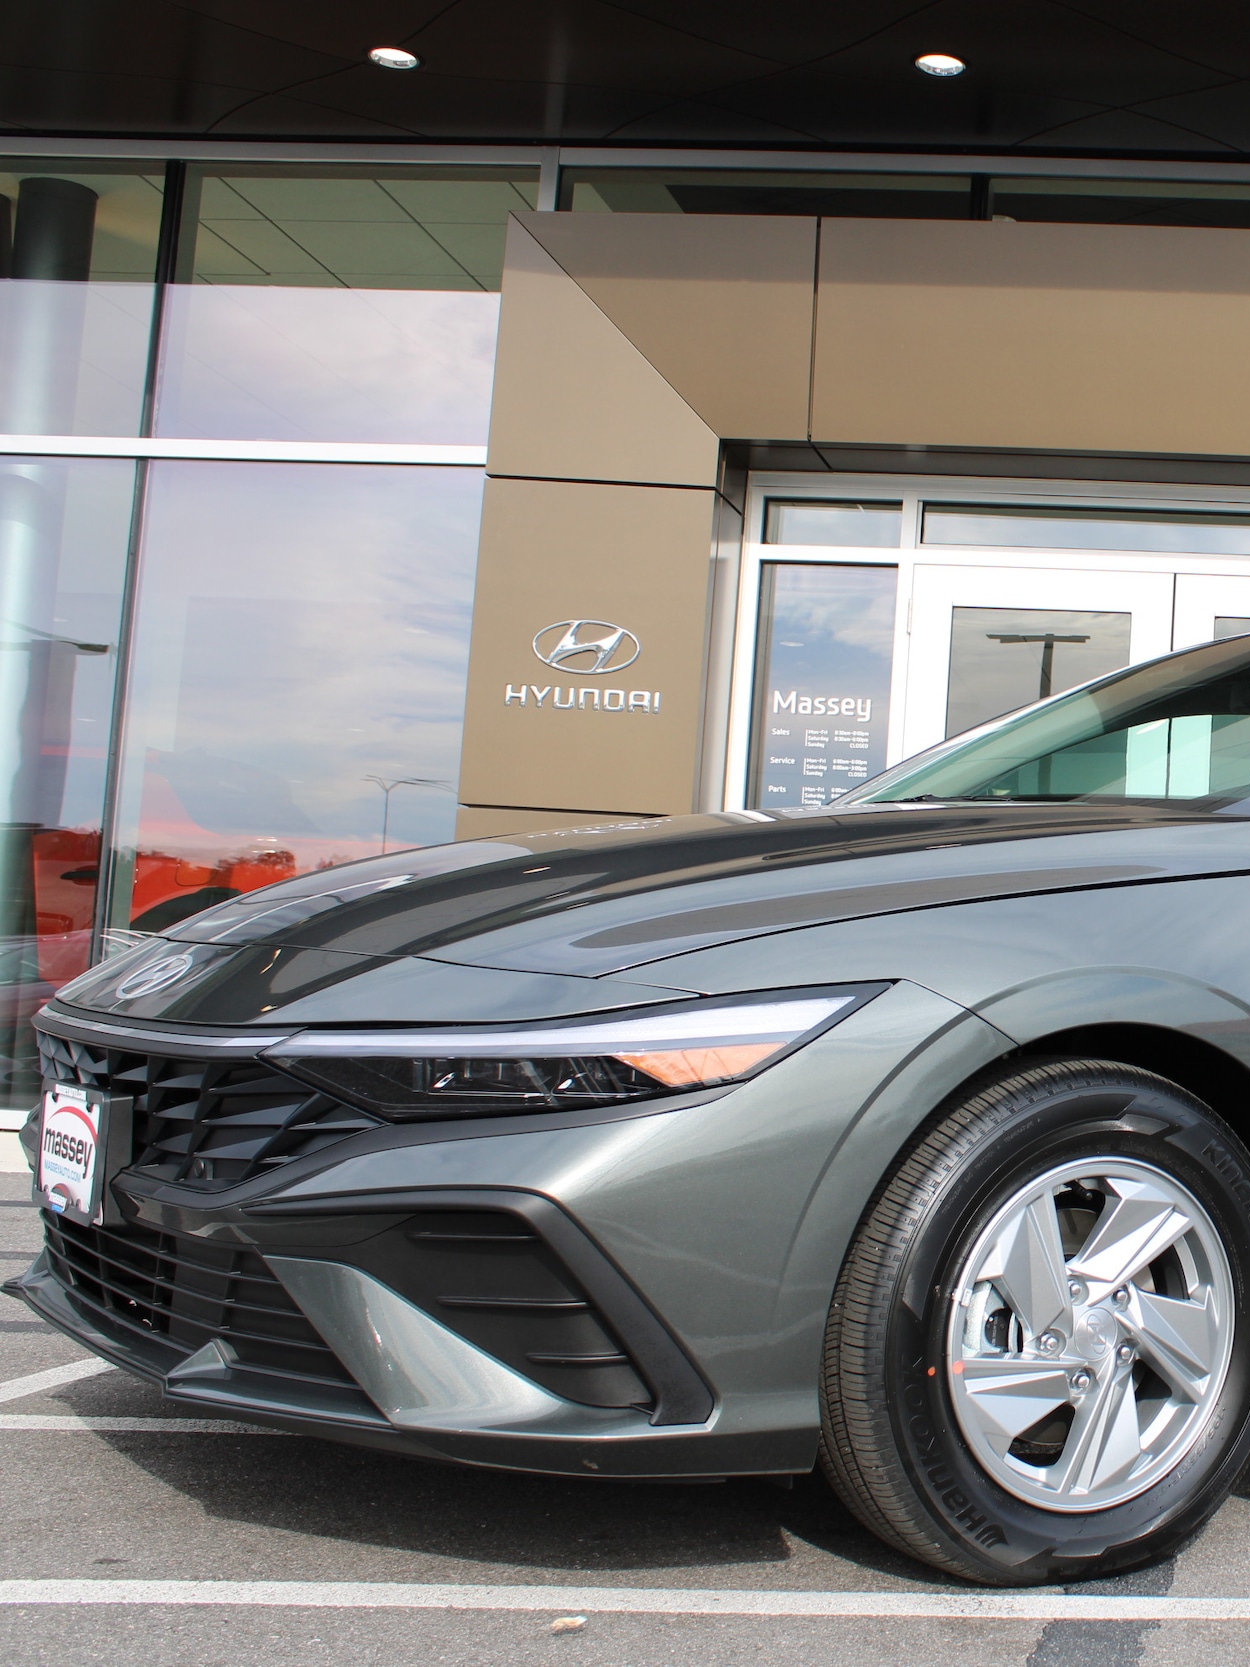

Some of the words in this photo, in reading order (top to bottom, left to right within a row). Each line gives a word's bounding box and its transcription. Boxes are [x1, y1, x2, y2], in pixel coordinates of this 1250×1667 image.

[504, 683, 661, 715] HYUNDAI
[773, 690, 872, 722] Massey
[771, 728, 790, 736] Sales
[769, 756, 796, 765] Service
[768, 785, 787, 793] Parts
[43, 1127, 93, 1180] massey
